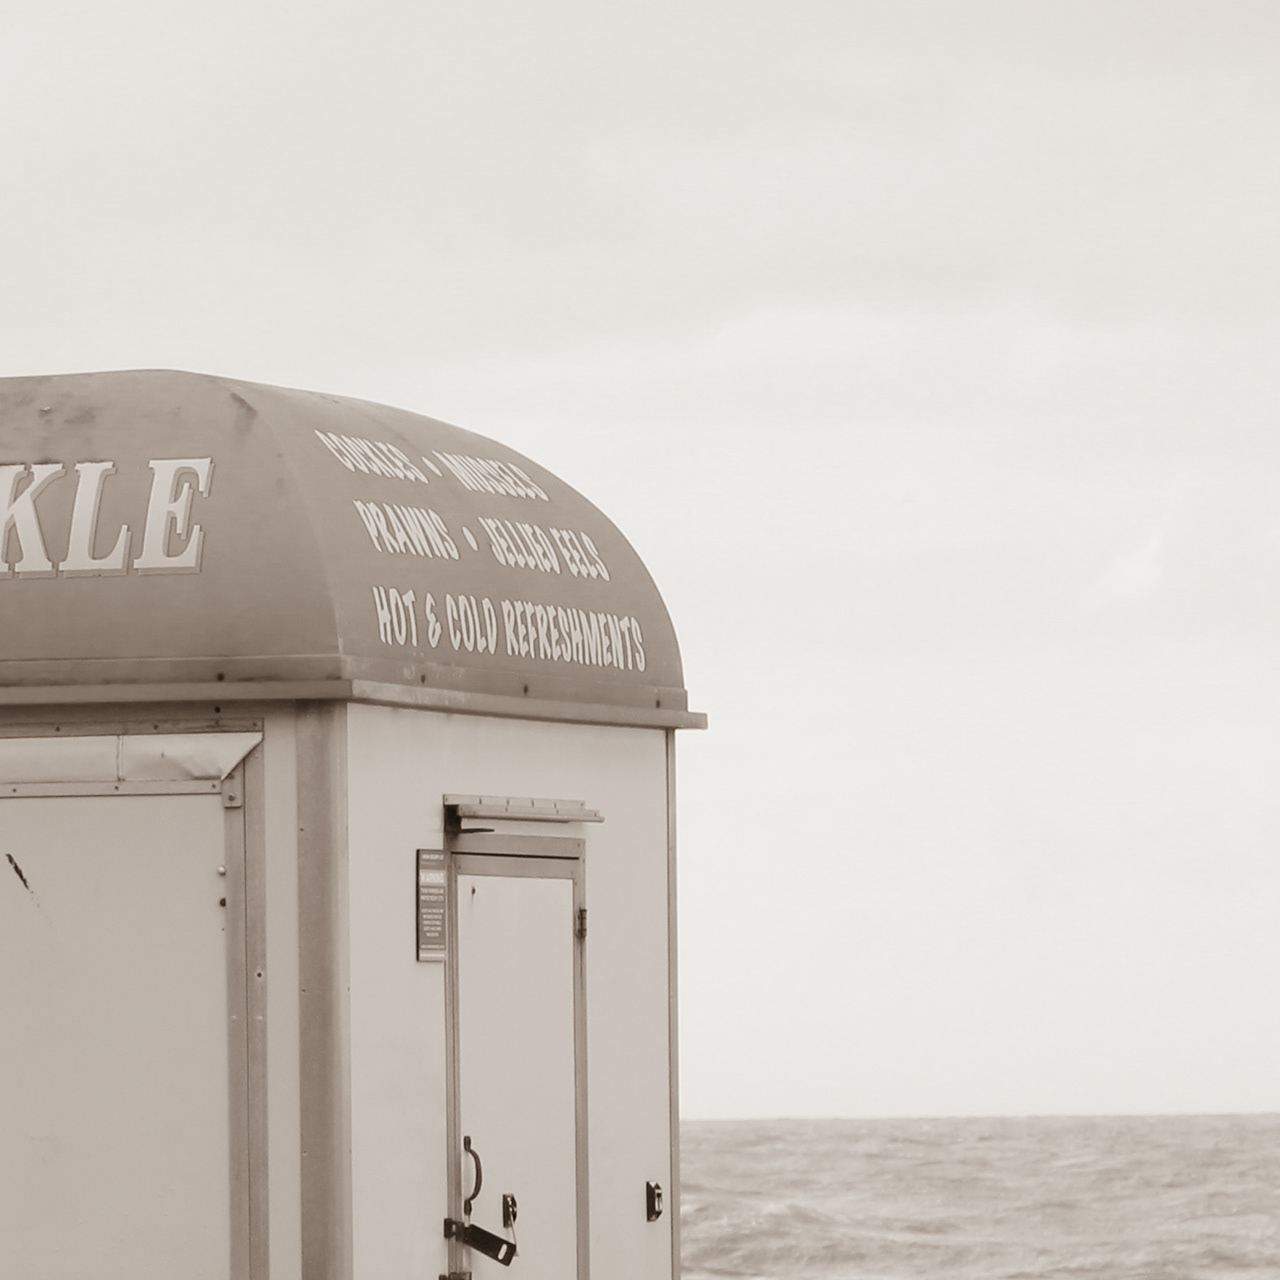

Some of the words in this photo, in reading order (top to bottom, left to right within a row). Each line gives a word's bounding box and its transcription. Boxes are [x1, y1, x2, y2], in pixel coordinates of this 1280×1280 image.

[314, 429, 429, 484] COCKLES
[432, 450, 549, 501] MUSSELS
[353, 499, 461, 560] PRAWNS
[477, 516, 561, 575] JELLIED
[549, 527, 610, 582] EELS
[372, 586, 418, 648] HOT
[425, 592, 442, 649] &
[445, 593, 498, 655] COLD
[501, 599, 646, 672] REFRESHMENTS
